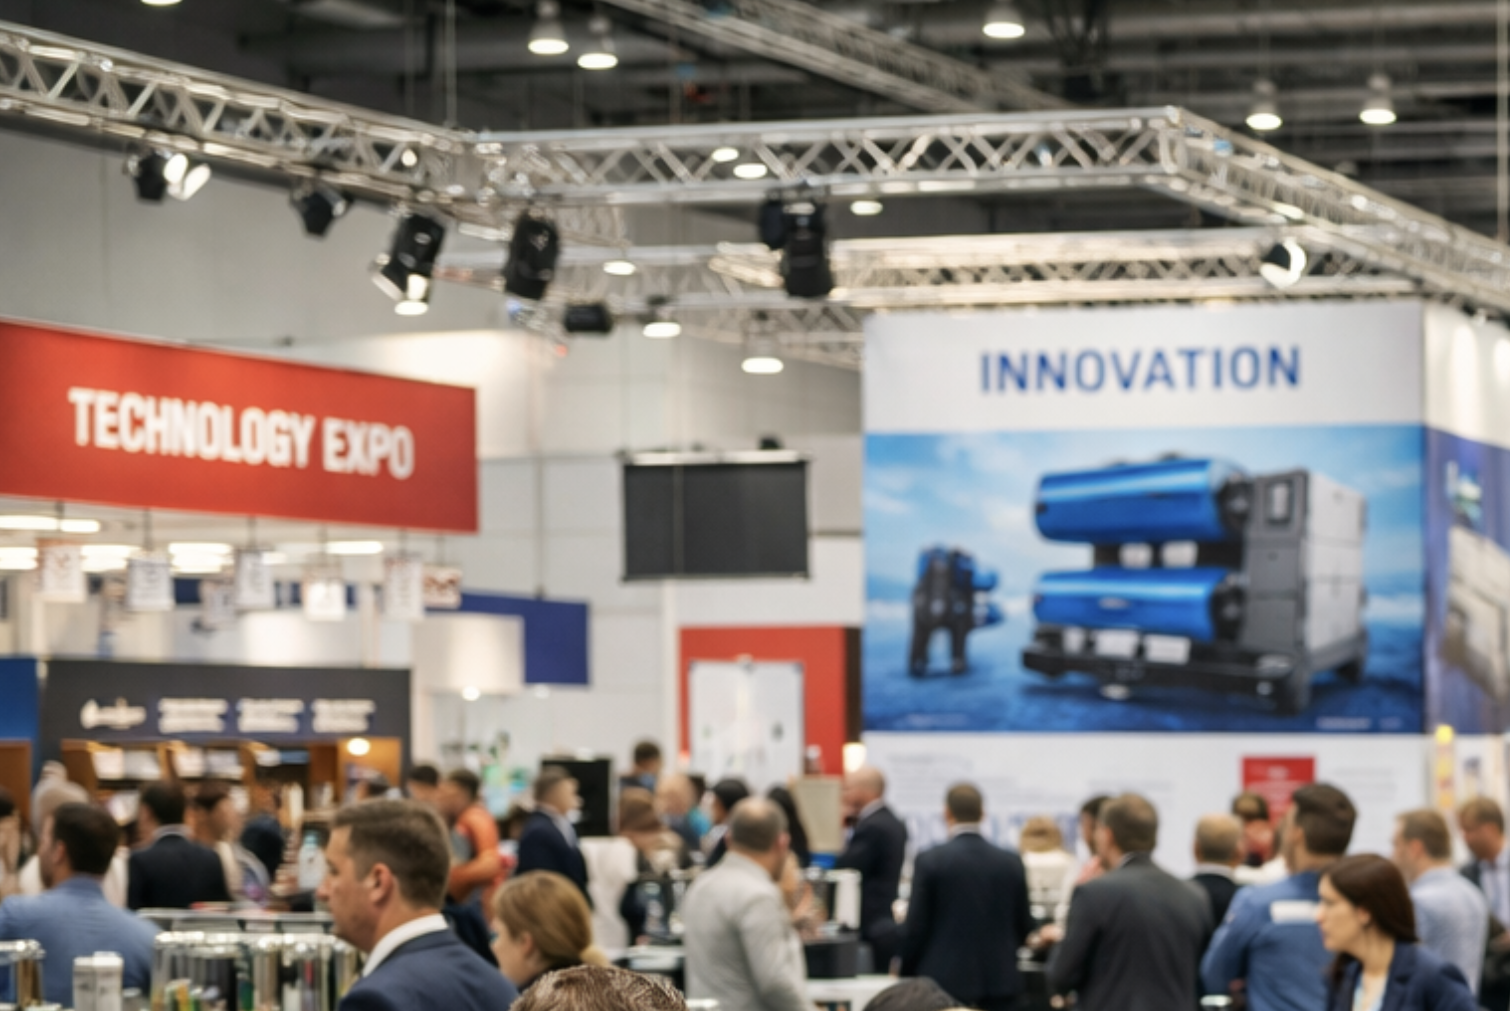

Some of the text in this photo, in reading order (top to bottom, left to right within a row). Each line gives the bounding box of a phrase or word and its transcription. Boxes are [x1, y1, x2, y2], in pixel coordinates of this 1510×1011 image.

[980, 345, 1302, 393] INNOVATION
[67, 386, 415, 479] TECHNOLOGY EXPO
